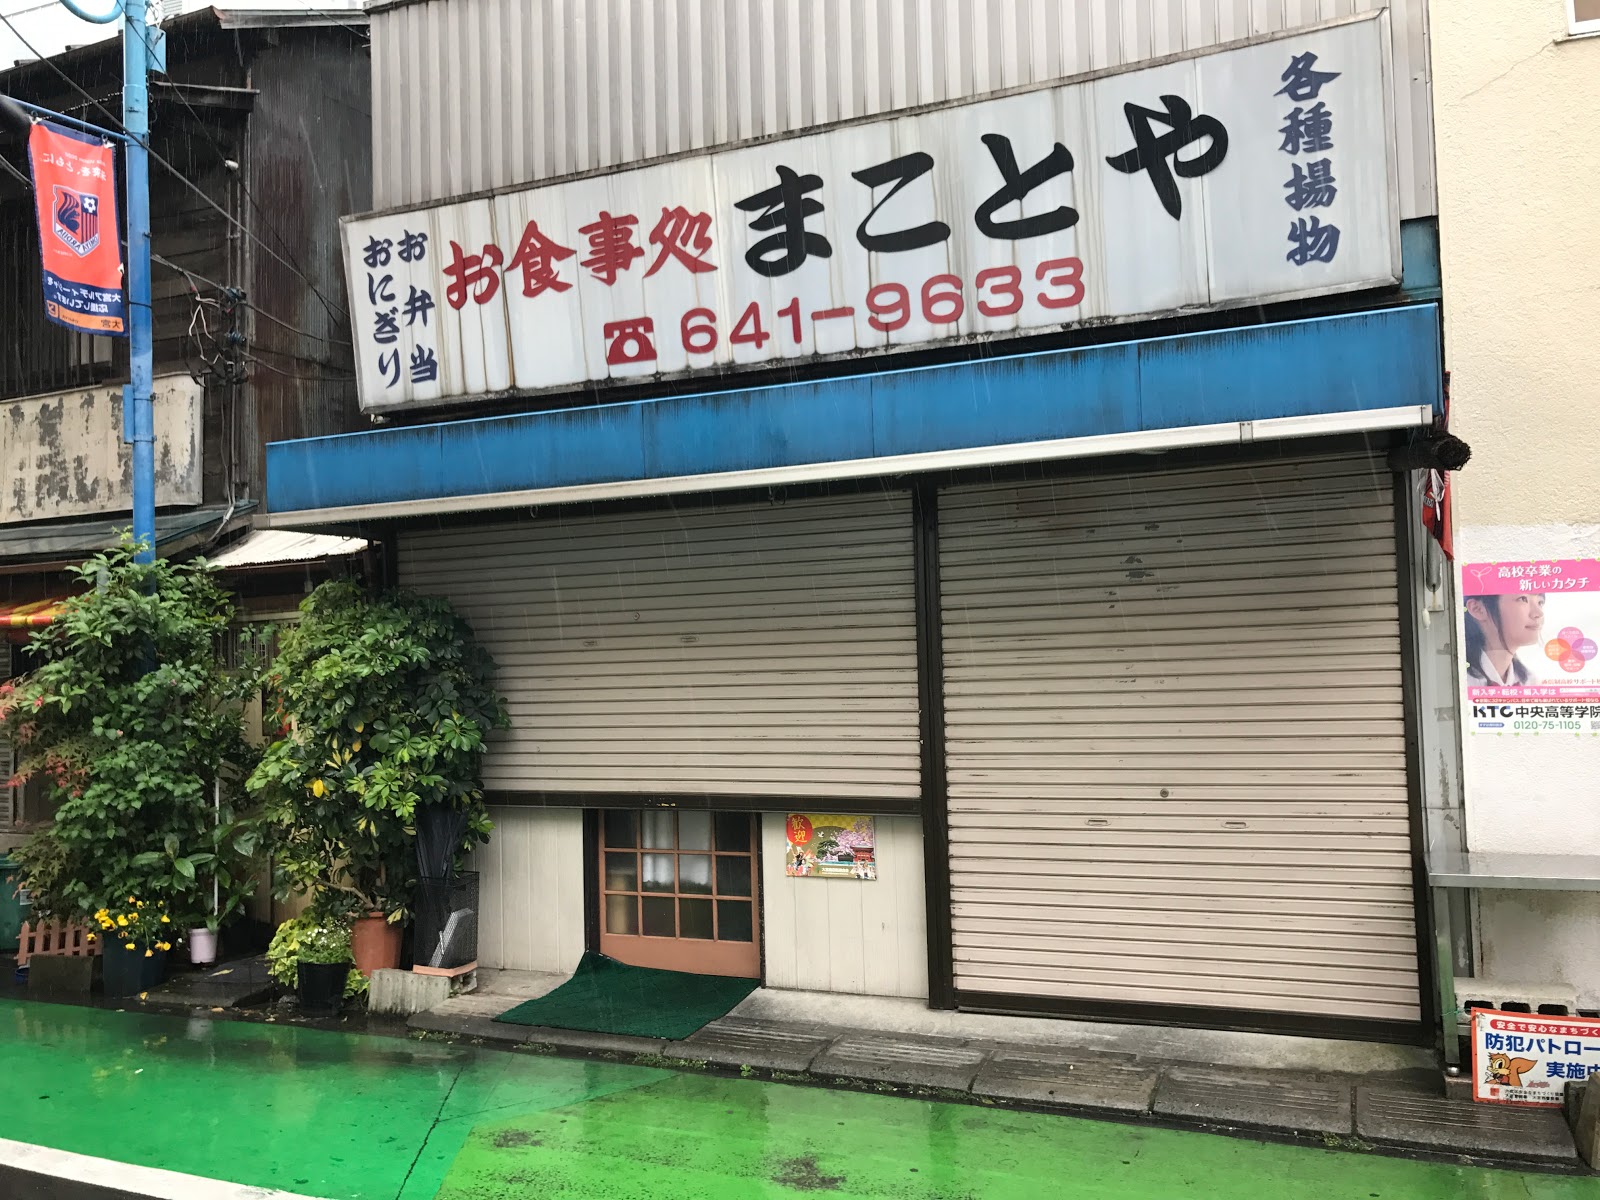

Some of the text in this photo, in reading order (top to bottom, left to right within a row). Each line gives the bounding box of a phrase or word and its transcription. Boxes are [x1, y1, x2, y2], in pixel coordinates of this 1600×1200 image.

[734, 93, 1229, 277] まことや
[1273, 51, 1342, 266] 各種揚物
[397, 229, 437, 384] お弁当
[442, 205, 718, 310] お食事処
[680, 256, 1085, 355] 641-9633
[363, 234, 401, 389] おにぎり
[1497, 565, 1562, 578] 高校卒業の
[1519, 577, 1590, 591] 新しいカタチ
[1513, 721, 1581, 730] 0120-75-1105
[1485, 1032, 1600, 1056] 防犯パトロー
[1496, 1020, 1599, 1036] 安全で安心なまちづく
